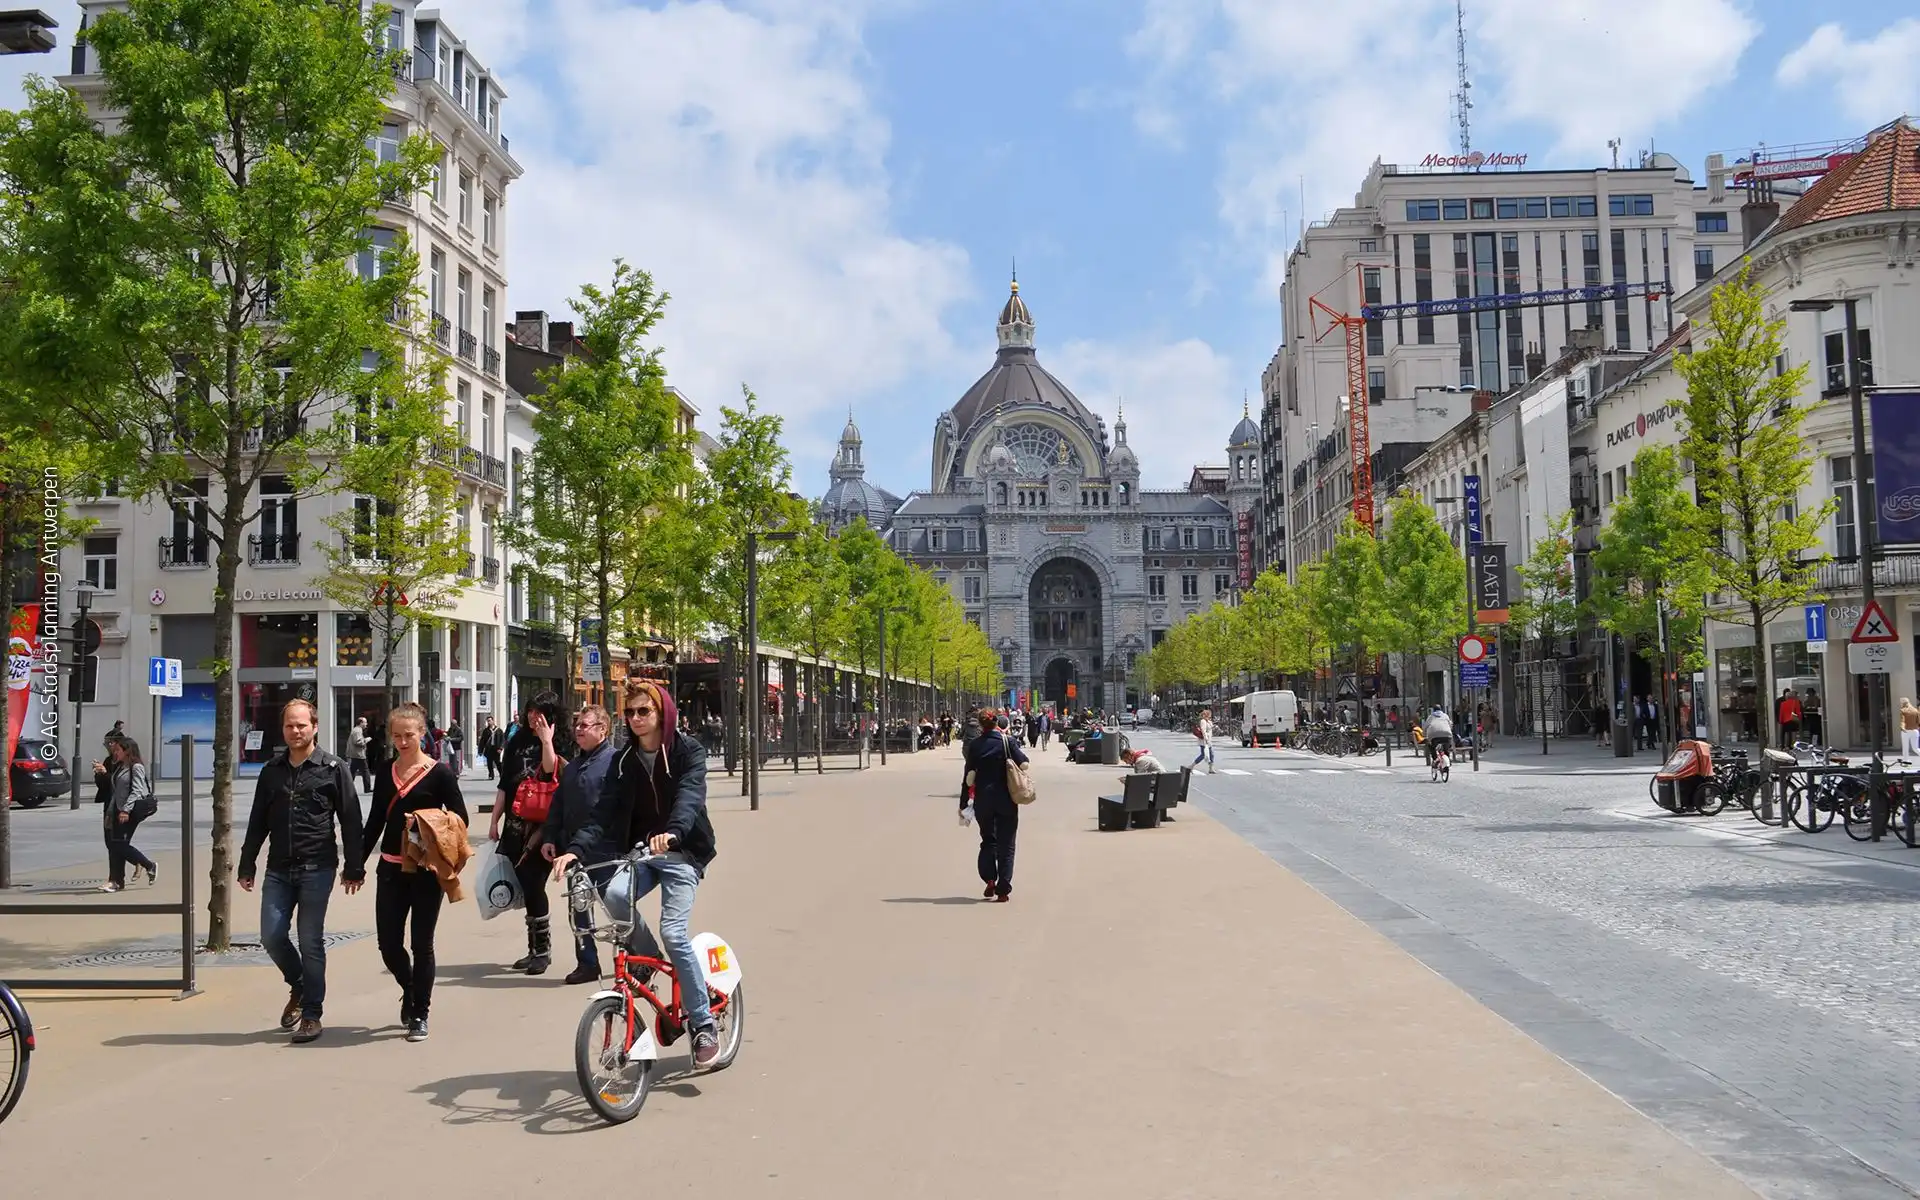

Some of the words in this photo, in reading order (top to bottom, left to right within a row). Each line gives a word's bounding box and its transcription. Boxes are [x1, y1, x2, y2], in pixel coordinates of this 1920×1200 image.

[1420, 153, 1468, 166] Media
[1484, 152, 1528, 165] Markt
[1756, 166, 1771, 175] VAN
[1772, 160, 1827, 173] CAMPENHOUT
[1606, 421, 1636, 448] PLANET
[1885, 494, 1920, 512] UGC
[1483, 555, 1500, 608] SLAETS
